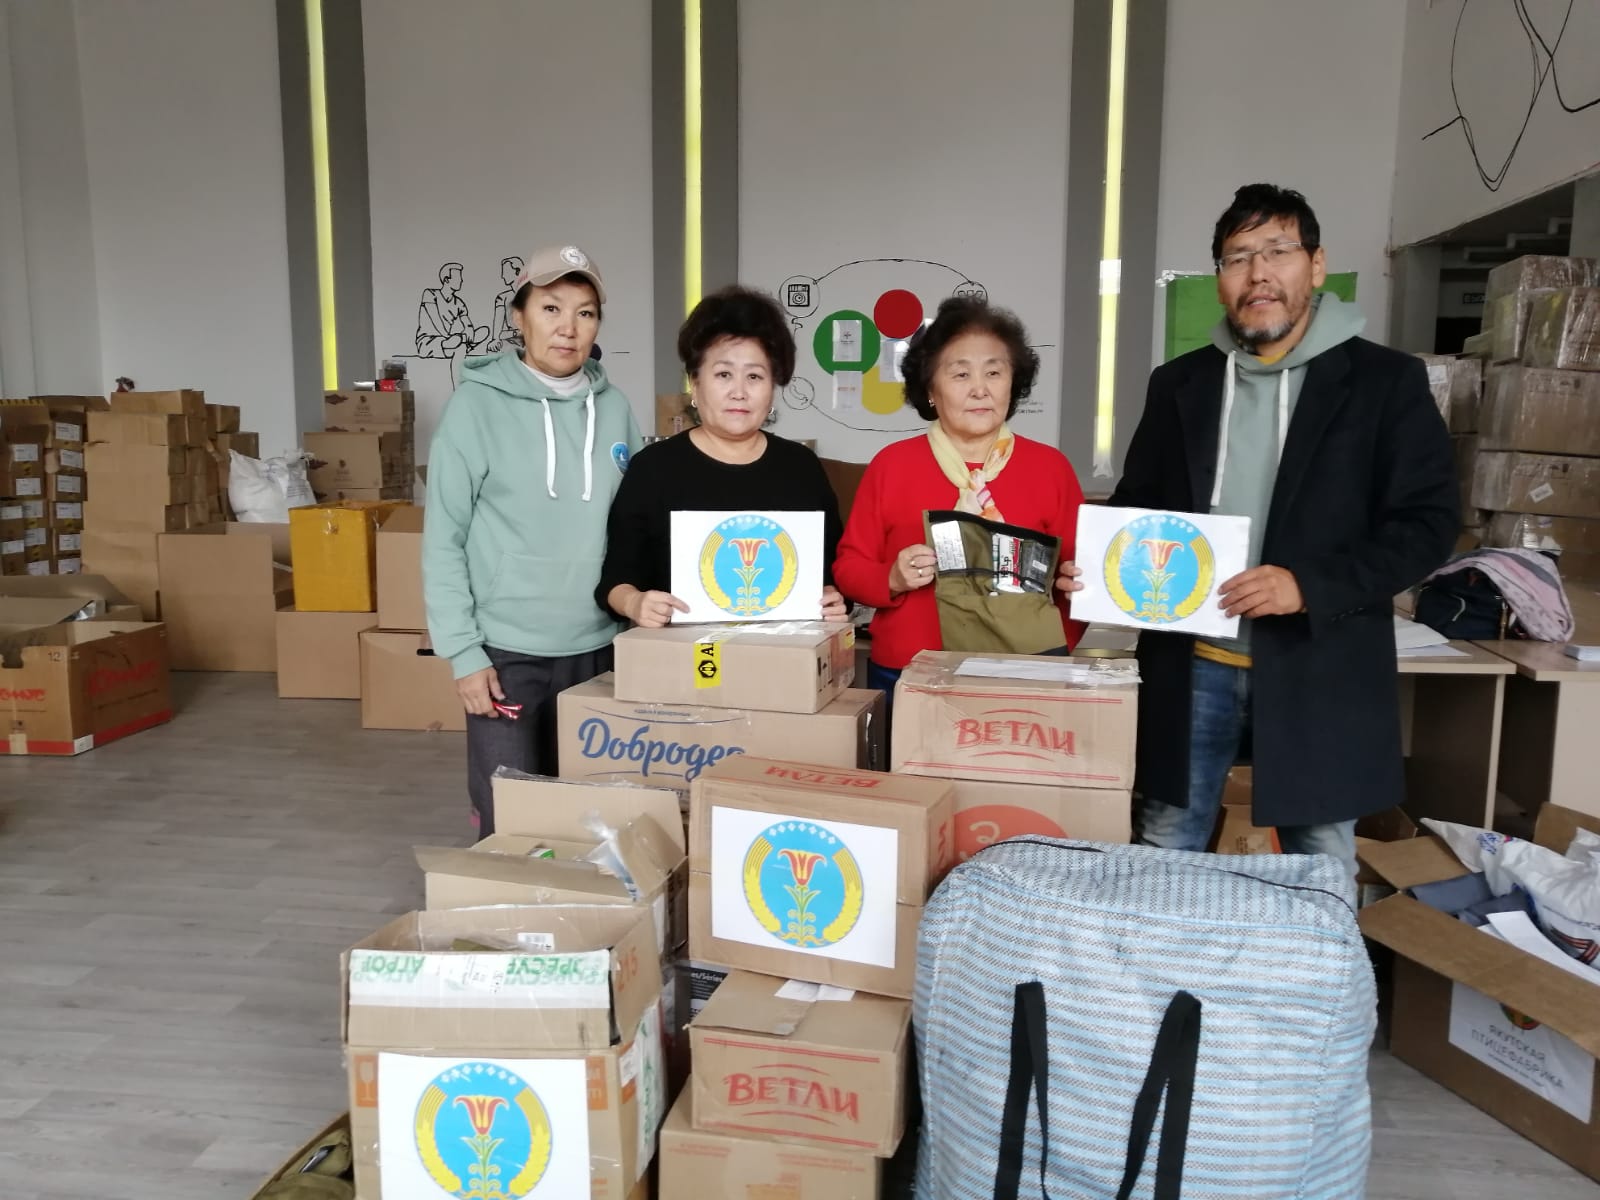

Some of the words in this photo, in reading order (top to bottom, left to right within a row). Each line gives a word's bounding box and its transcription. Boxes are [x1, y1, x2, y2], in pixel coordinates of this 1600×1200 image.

[578, 717, 746, 783] Доброде
[954, 717, 1078, 757] ВЕТЛИ
[763, 765, 882, 789] ВЕТЛИ
[723, 1072, 861, 1122] ВЕТЛИ
